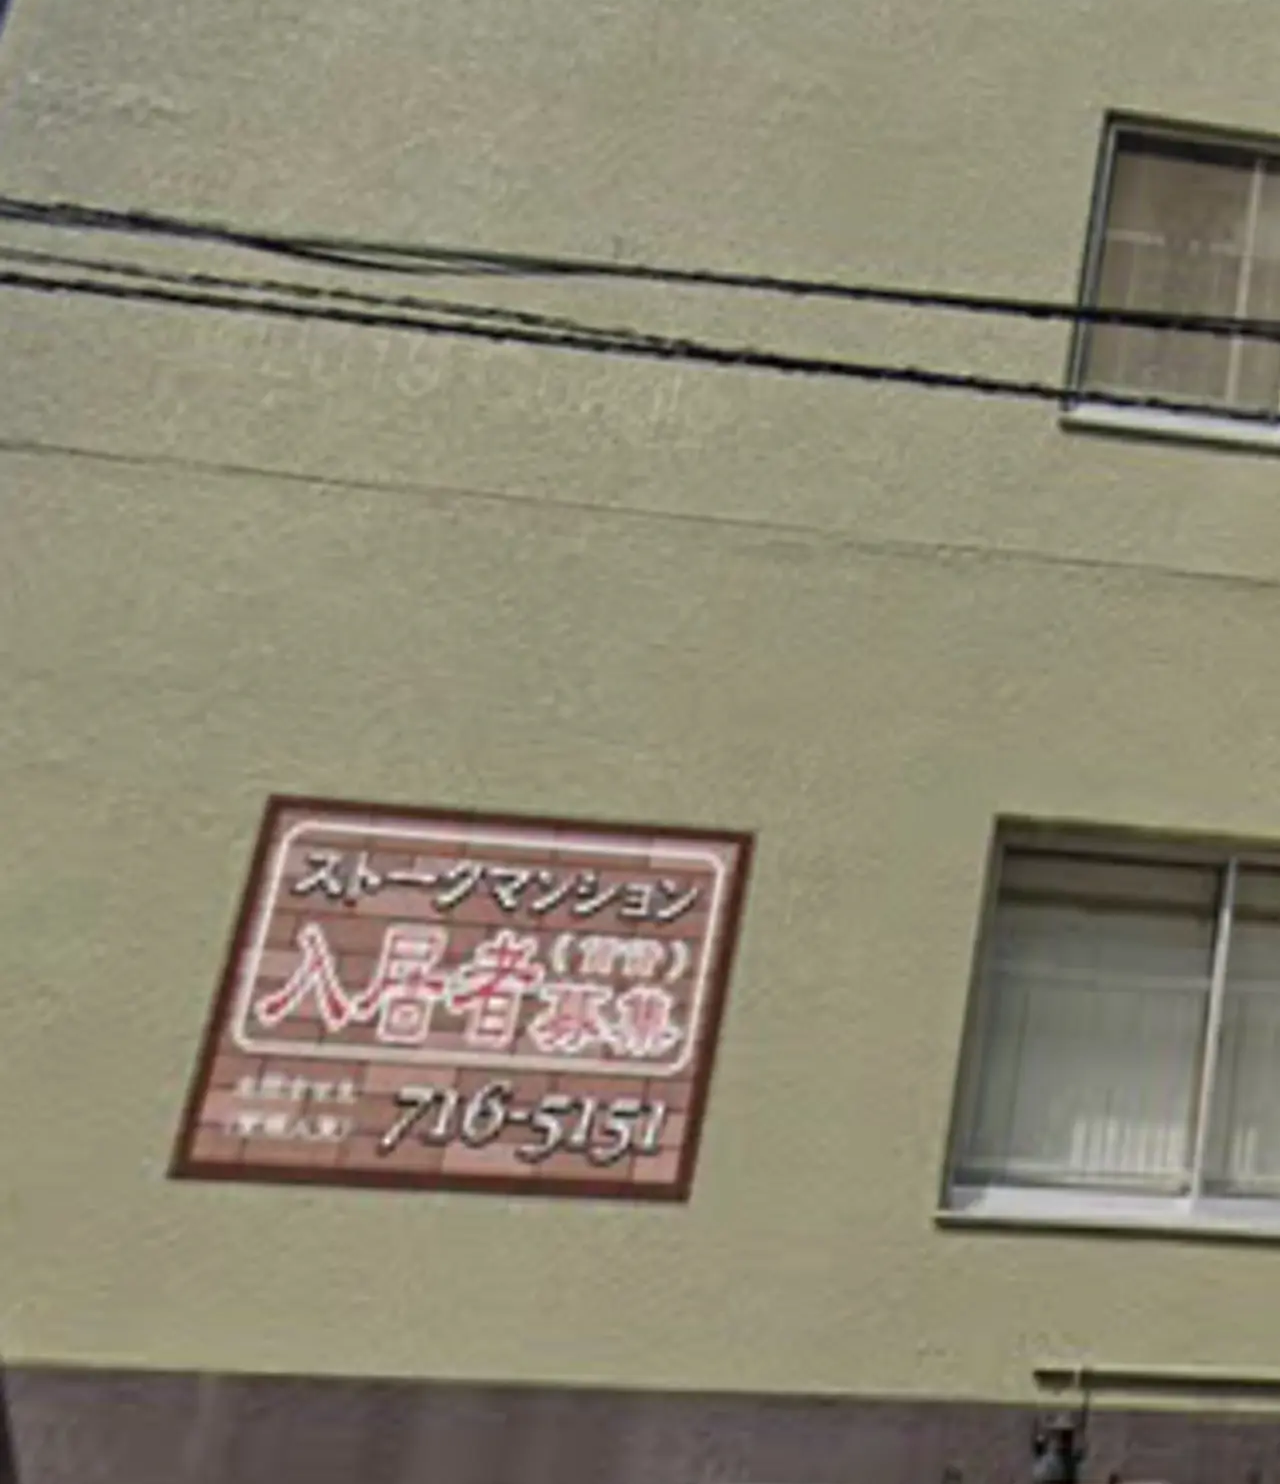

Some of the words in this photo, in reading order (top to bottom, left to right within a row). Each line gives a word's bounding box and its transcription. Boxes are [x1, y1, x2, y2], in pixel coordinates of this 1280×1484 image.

[294, 848, 701, 923] ストークマンション
[378, 1077, 667, 1168] 716-5151
